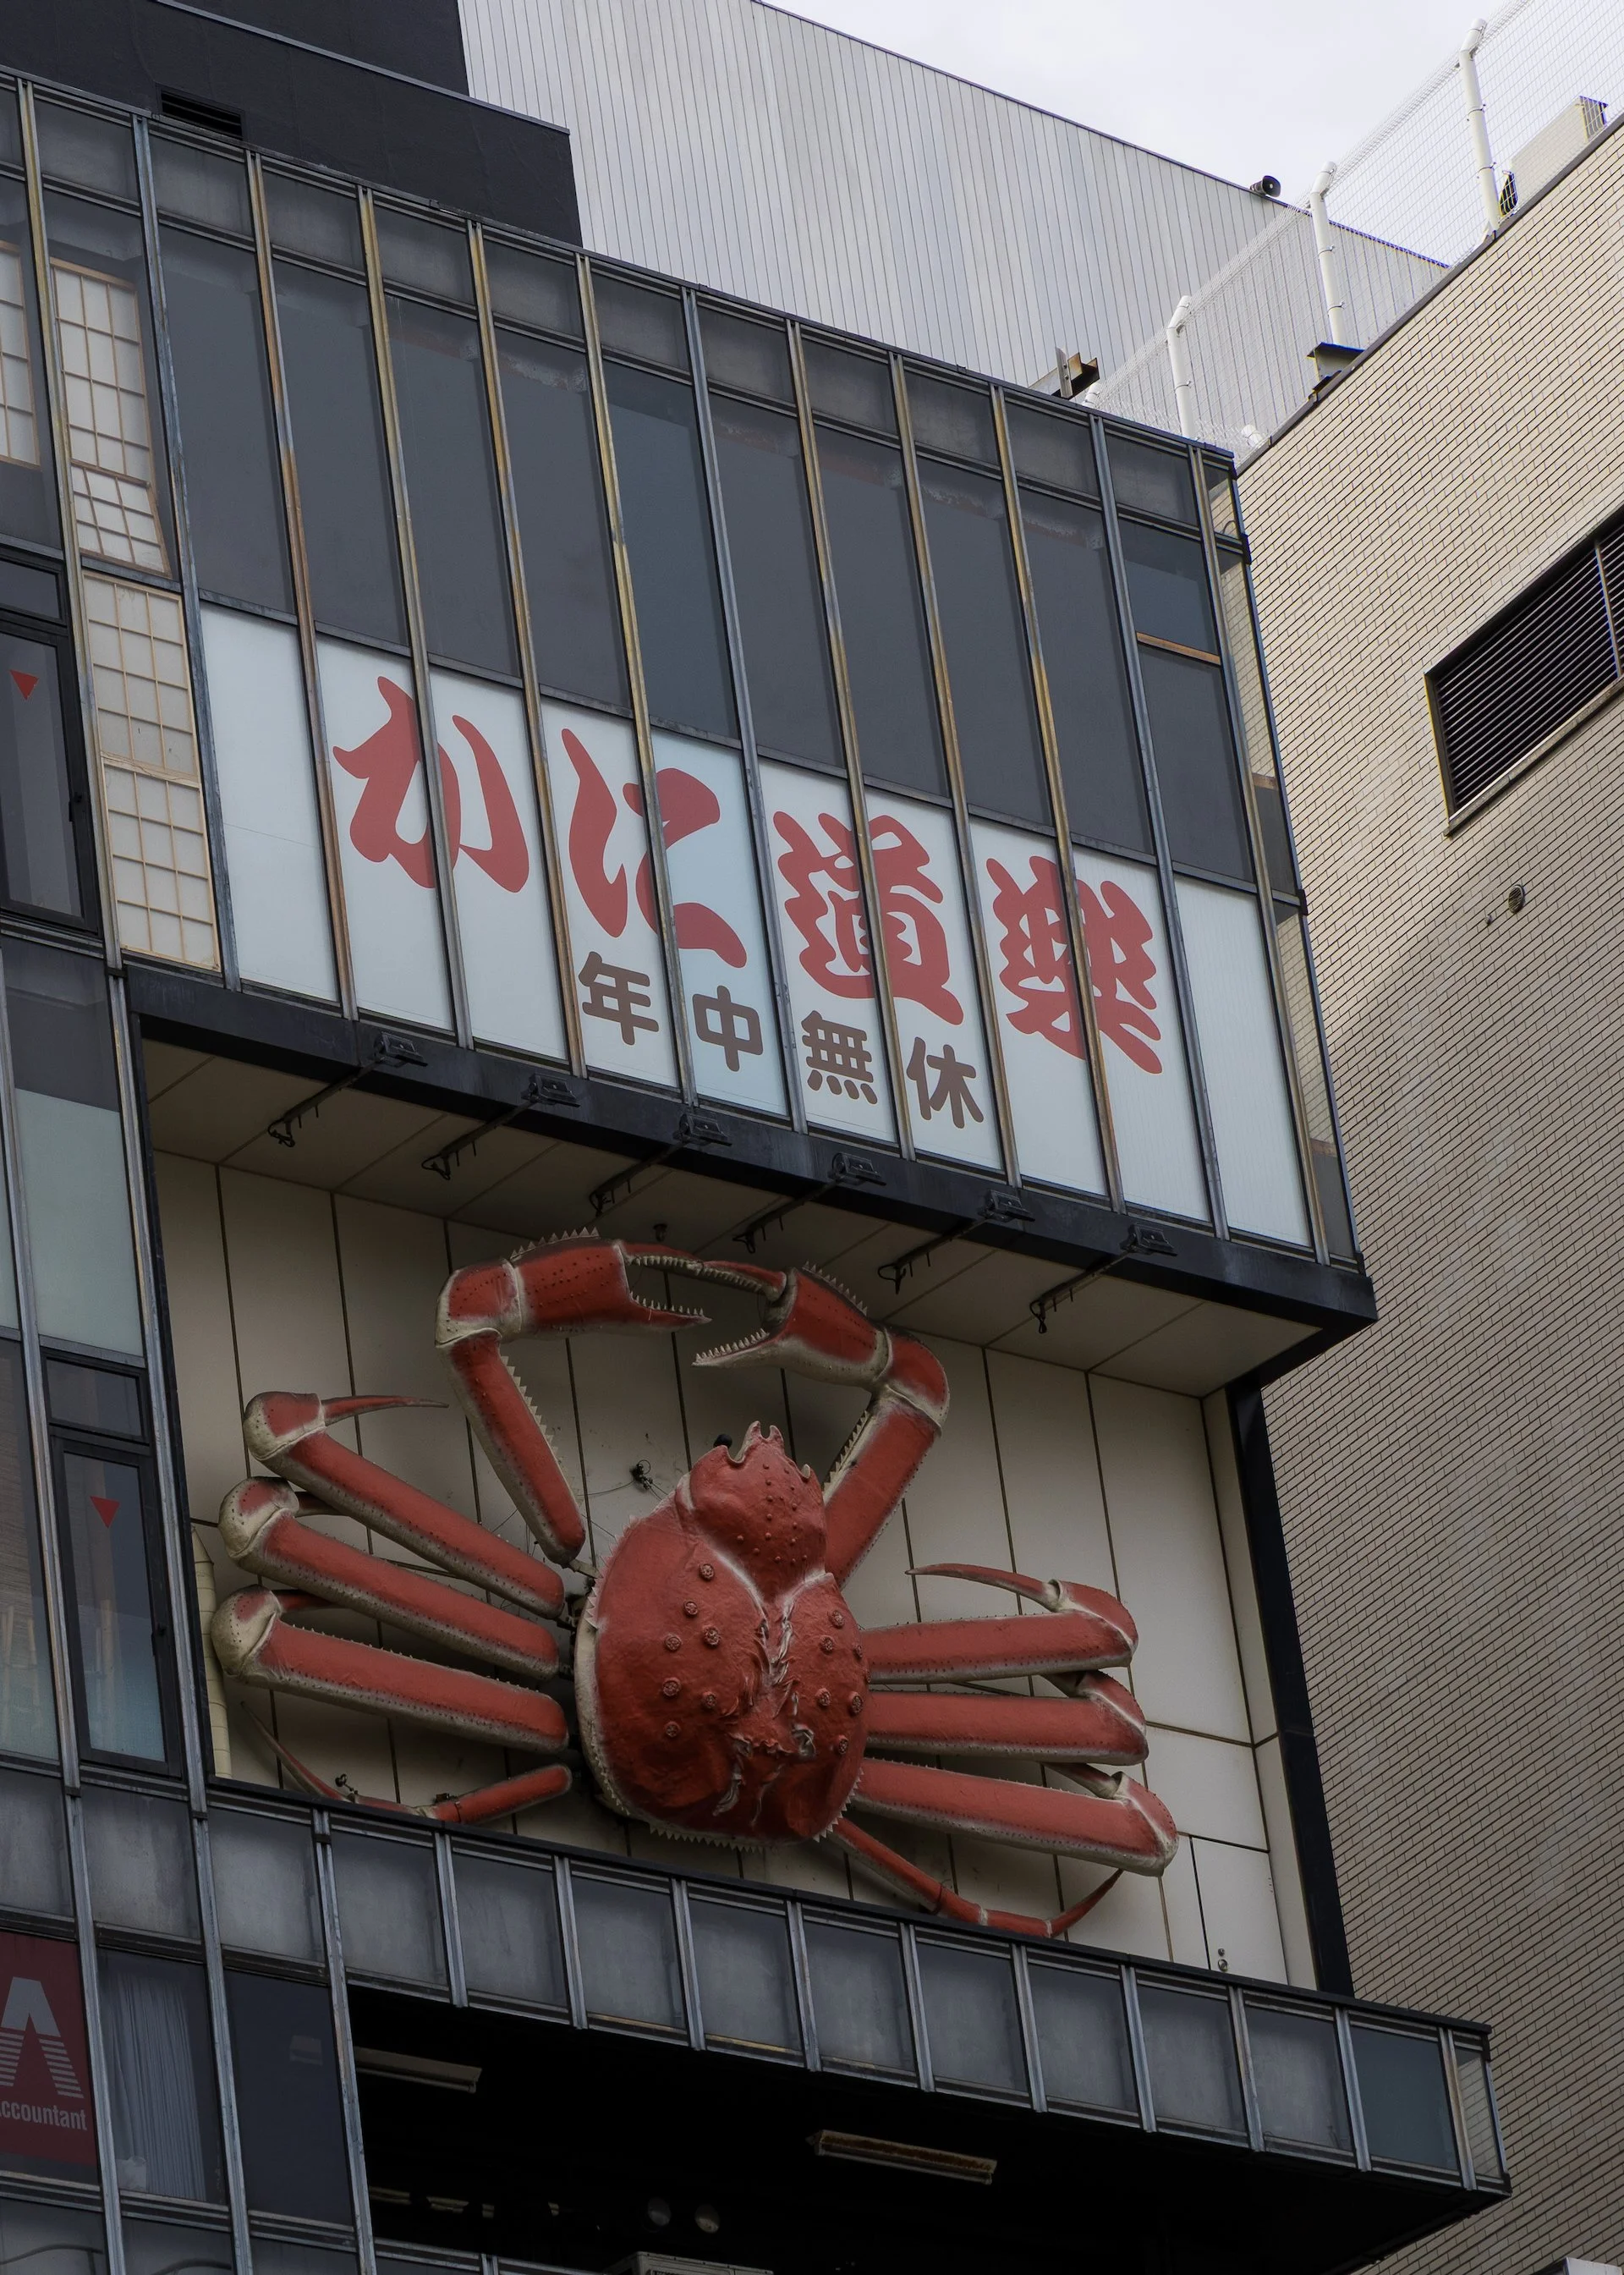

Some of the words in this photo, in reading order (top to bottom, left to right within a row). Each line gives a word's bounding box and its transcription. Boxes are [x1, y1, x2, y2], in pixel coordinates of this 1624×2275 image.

[579, 951, 984, 1129] 年中無休
[0, 2100, 87, 2130] ccountant
